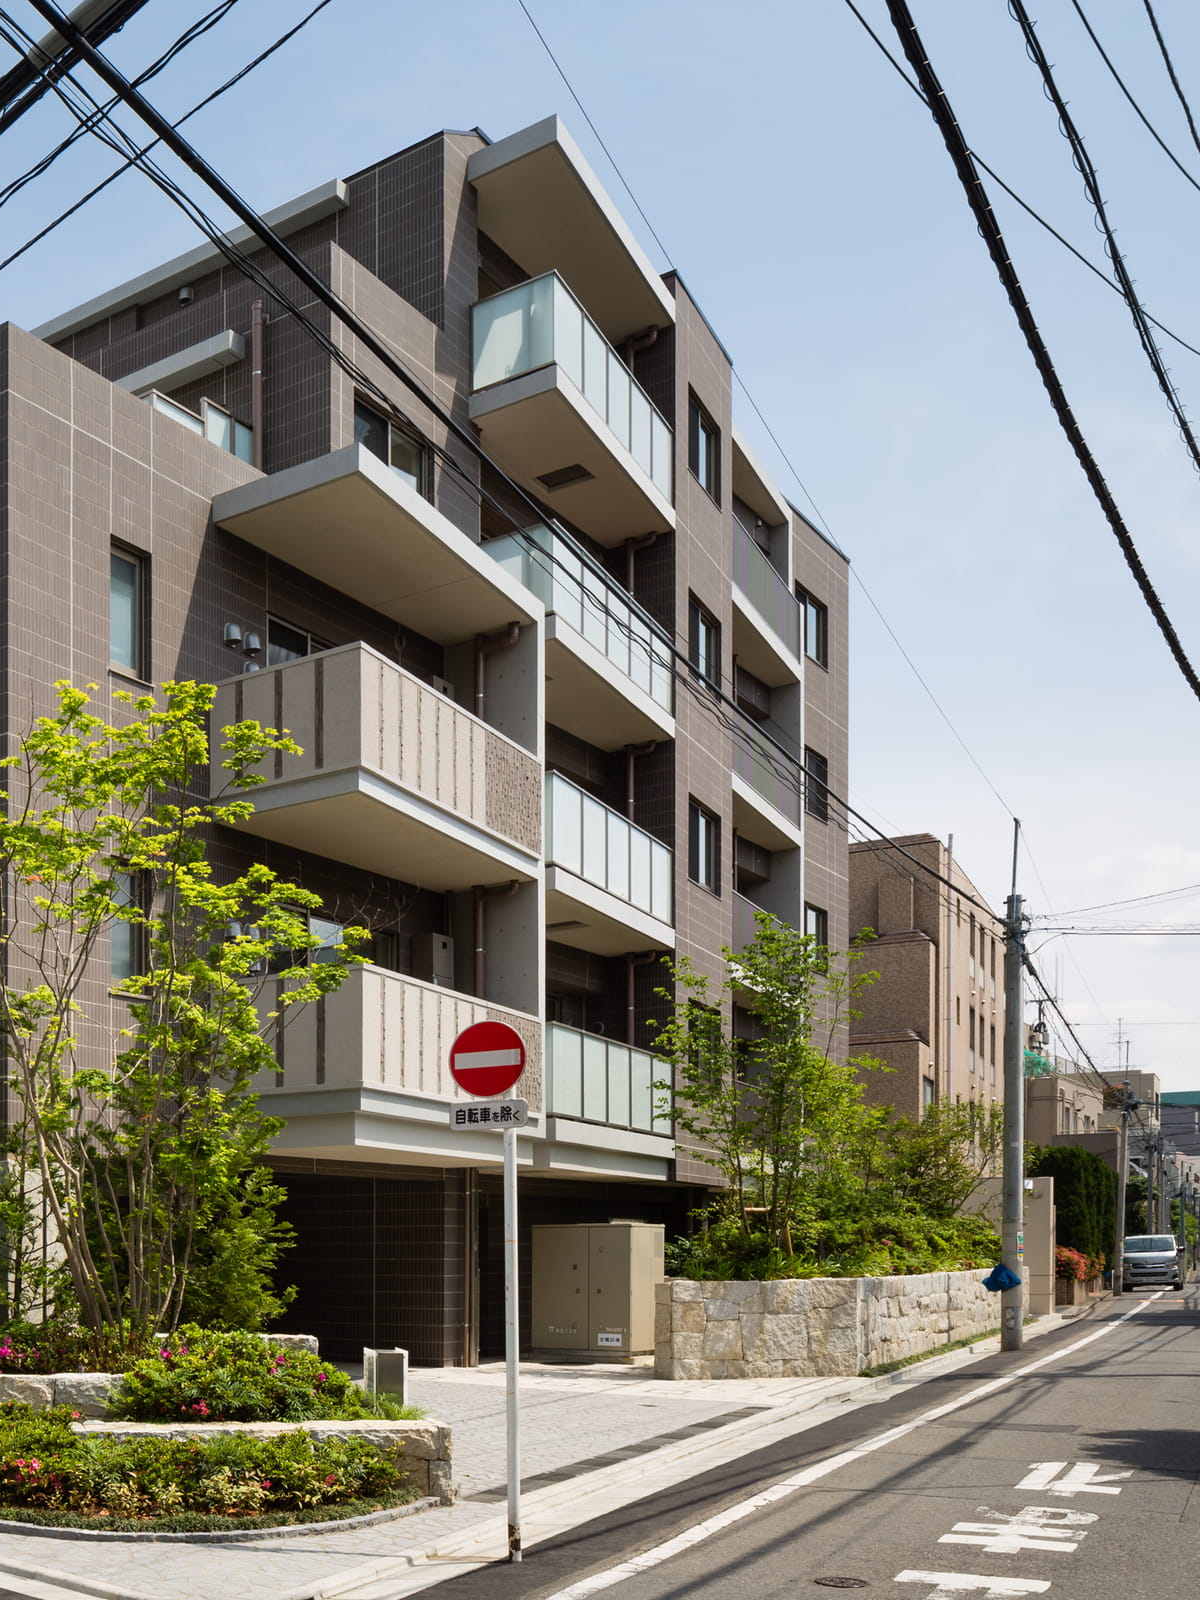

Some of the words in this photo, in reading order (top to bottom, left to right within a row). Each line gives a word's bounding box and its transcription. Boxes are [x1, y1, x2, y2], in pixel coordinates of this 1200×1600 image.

[455, 1105, 520, 1125] 自転車を除く
